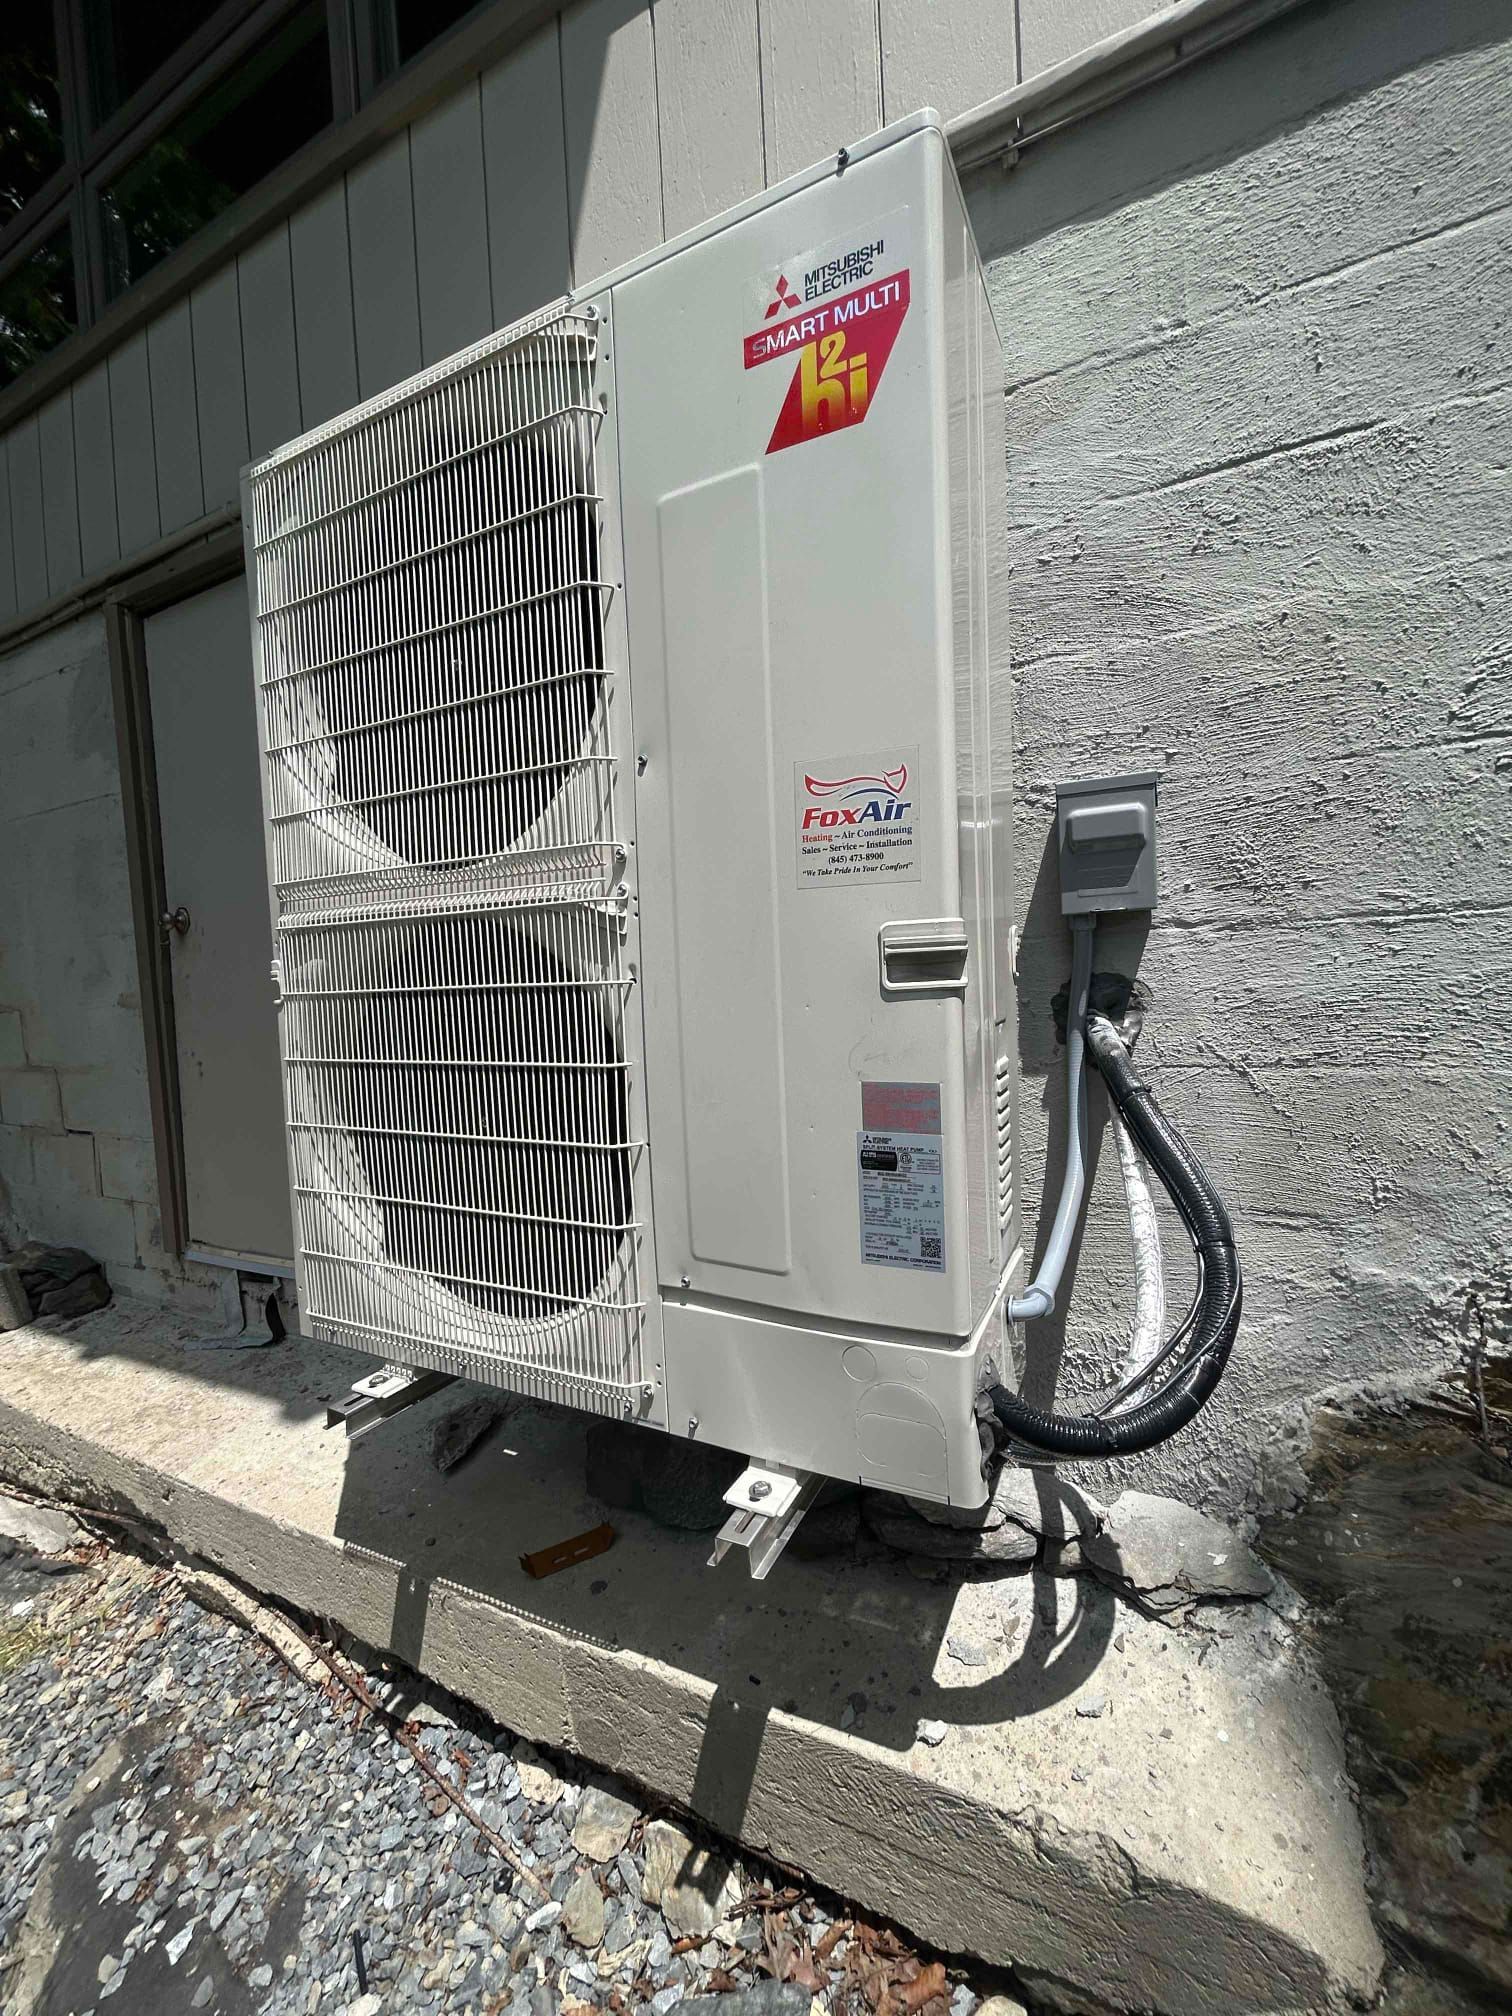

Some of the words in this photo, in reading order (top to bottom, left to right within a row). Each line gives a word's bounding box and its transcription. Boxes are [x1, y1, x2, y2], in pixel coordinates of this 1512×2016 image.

[805, 240, 884, 287] MITSUBISHI
[805, 261, 873, 302] ELECTRIC
[753, 310, 828, 359] SMART
[834, 281, 899, 325] MULTI
[802, 799, 911, 829] FoxAir
[802, 834, 832, 843] Heating
[842, 831, 855, 839] Air
[857, 826, 912, 837] Conditioning
[802, 846, 821, 854] Sales
[830, 842, 857, 852] Service
[866, 838, 912, 848] Installation
[828, 855, 847, 864] (845)
[849, 852, 884, 862] 473-8900
[834, 866, 851, 874] Pride
[863, 863, 878, 872] Your
